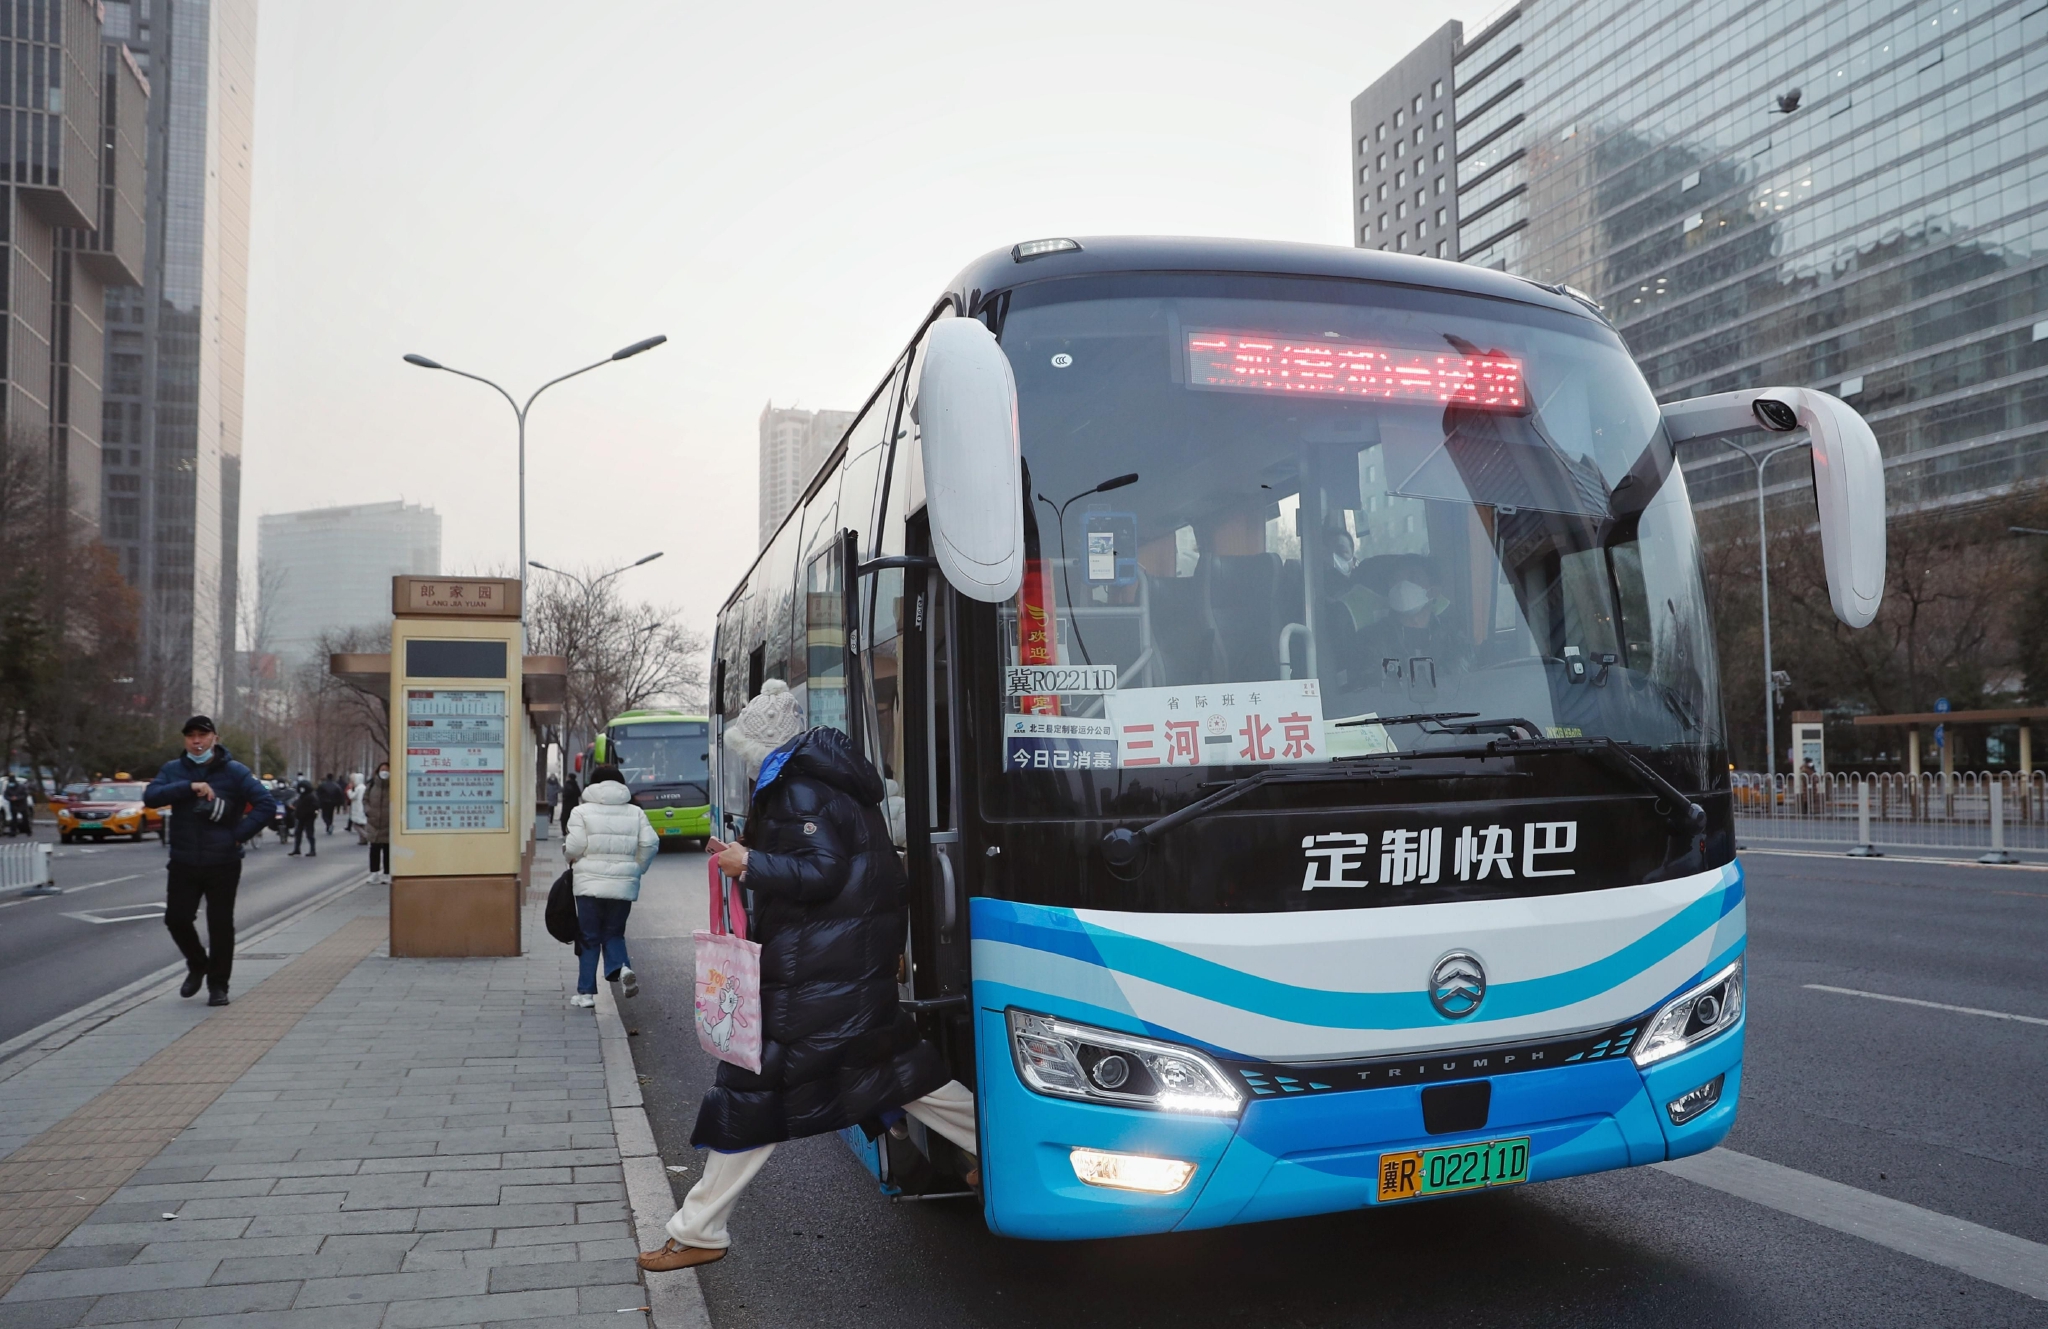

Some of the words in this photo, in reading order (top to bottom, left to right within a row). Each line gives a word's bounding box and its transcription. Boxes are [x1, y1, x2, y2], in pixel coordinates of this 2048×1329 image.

[420, 585, 492, 600] 郎家园
[466, 600, 487, 608] YUAN
[1007, 668, 1116, 696] 冀R02211D
[1166, 691, 1263, 711] 省际班车
[1029, 723, 1111, 735] 北三县定制客运分公司
[420, 757, 452, 767] 上车站
[1012, 748, 1112, 770] 今日已消毒
[1301, 820, 1578, 892] 定制快巴
[708, 968, 726, 988] YOU
[1358, 1051, 1545, 1080] TRIUMPH
[1430, 1145, 1526, 1188] 02211D
